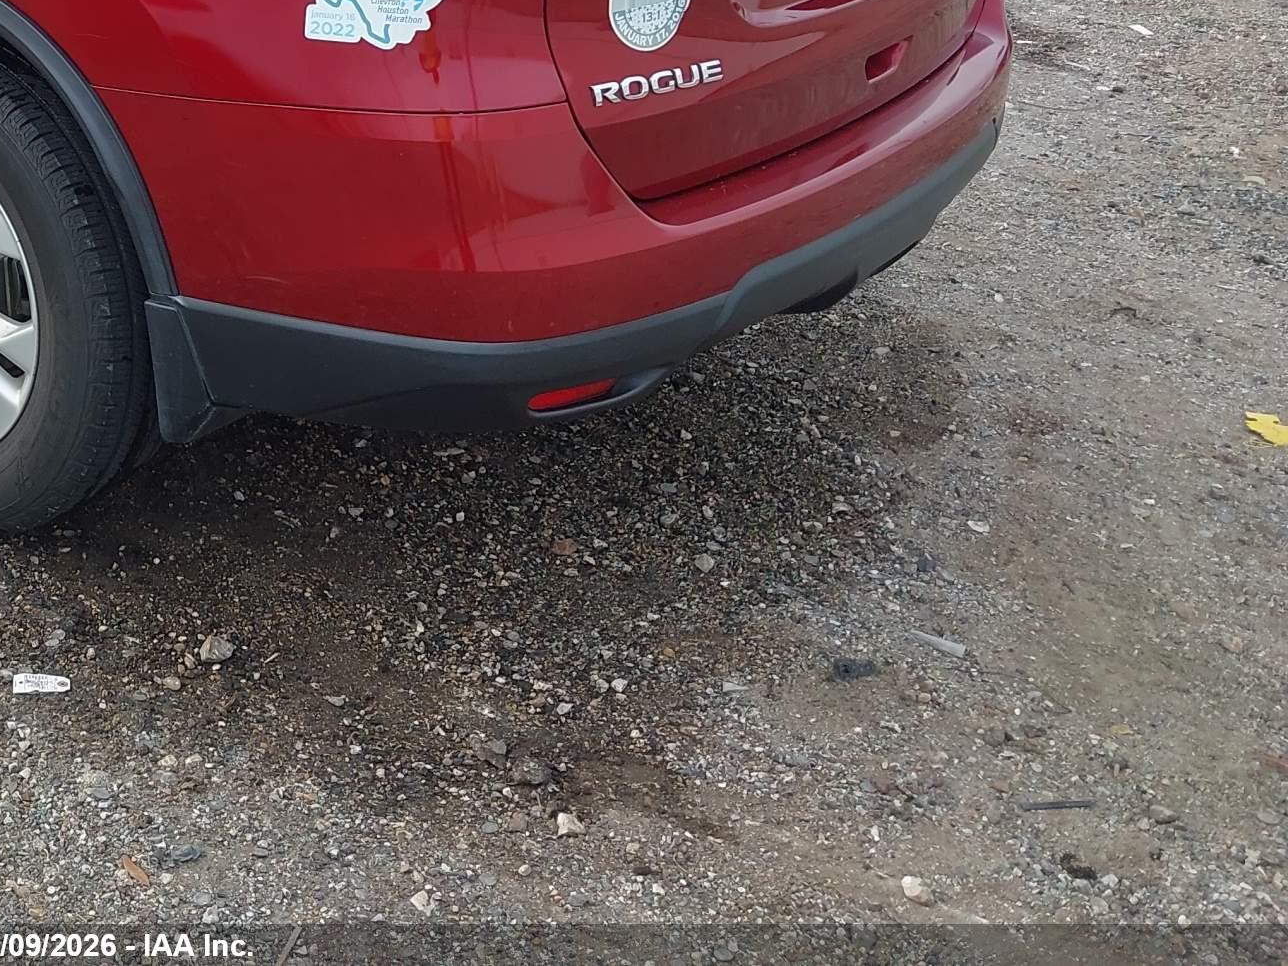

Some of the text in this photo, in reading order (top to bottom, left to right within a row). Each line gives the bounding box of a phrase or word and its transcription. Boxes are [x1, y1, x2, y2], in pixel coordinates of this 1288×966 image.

[310, 9, 344, 21] January
[377, 5, 410, 15] Houston
[385, 14, 423, 24] Marathon
[310, 22, 356, 37] 2022
[615, 12, 655, 47] JANUARY
[655, 28, 669, 44] 17,
[590, 59, 724, 107] ROGUE
